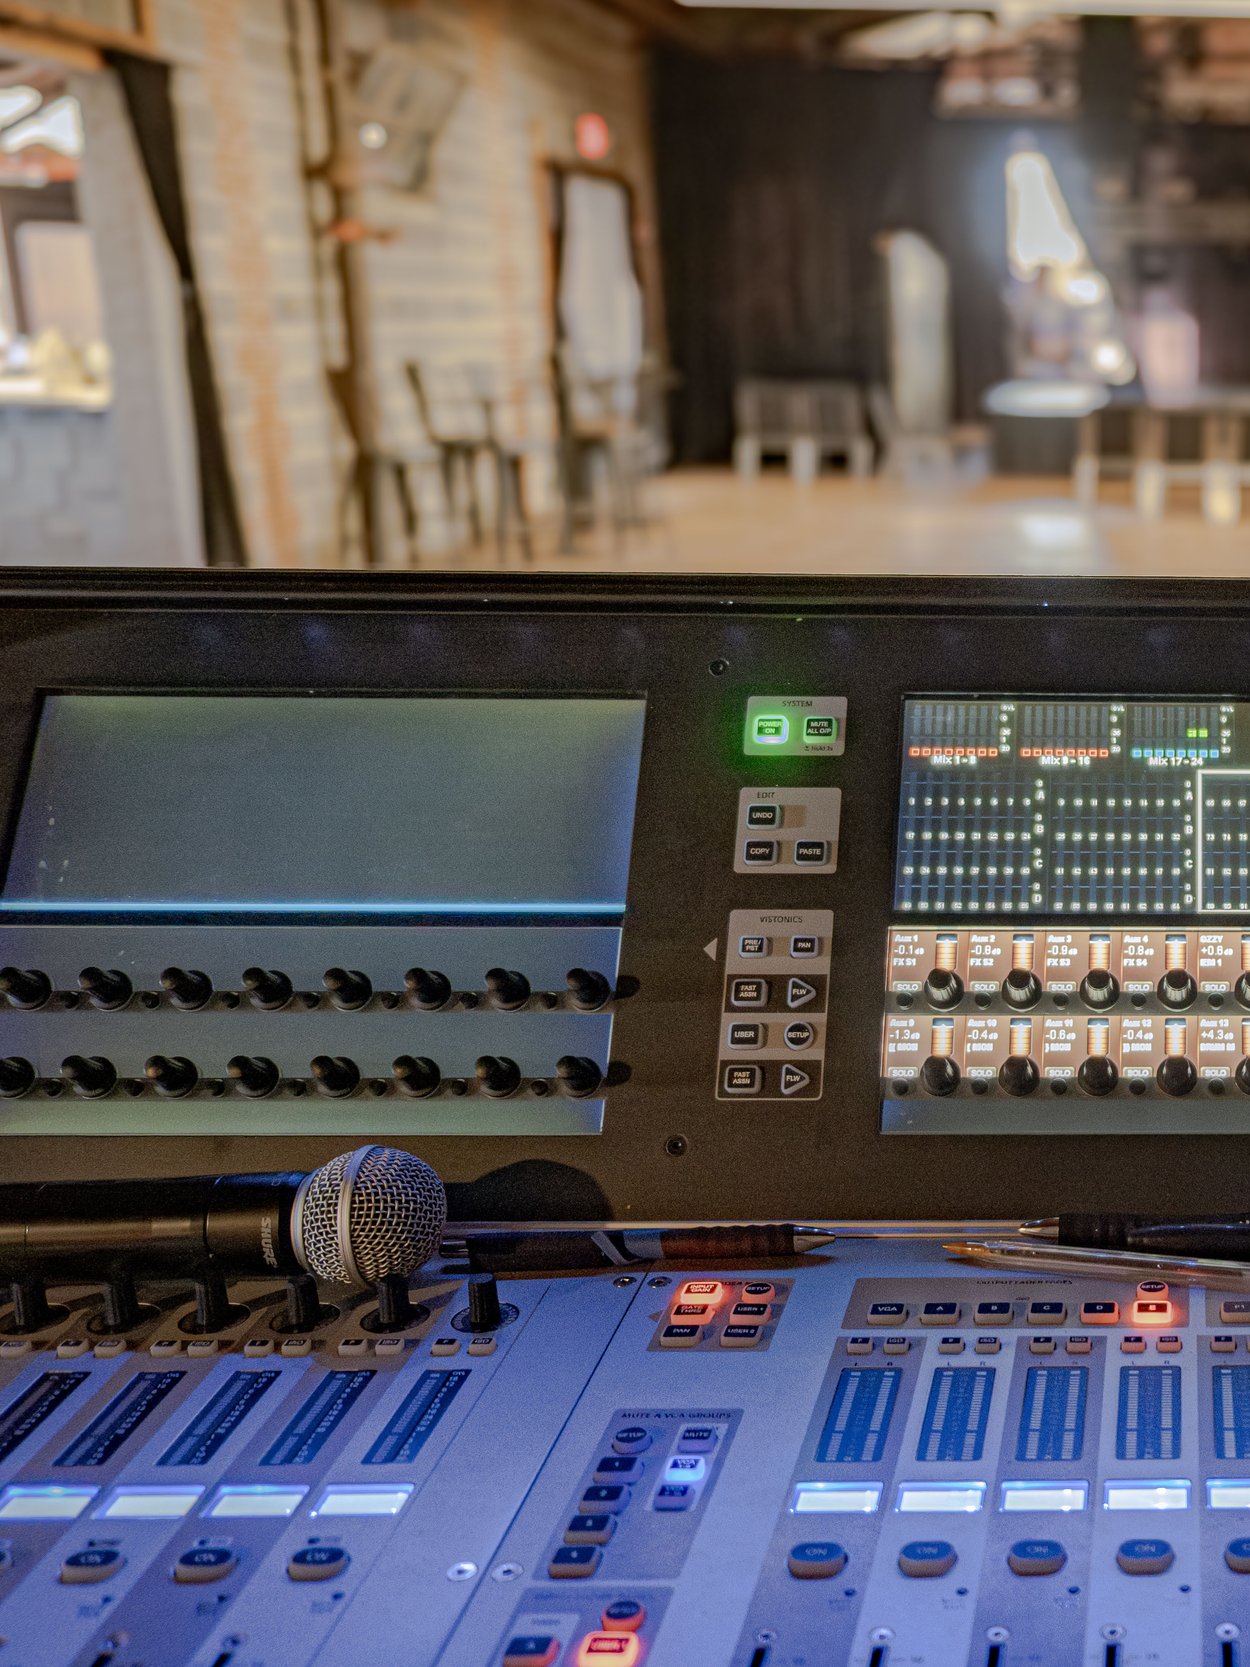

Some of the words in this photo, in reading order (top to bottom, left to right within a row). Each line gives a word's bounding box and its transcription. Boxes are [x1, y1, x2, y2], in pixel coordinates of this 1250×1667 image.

[781, 699, 813, 707] SYSTEM
[933, 755, 952, 764] Mix
[1041, 756, 1060, 765] Mix
[1148, 757, 1168, 765] Mix
[1190, 757, 1203, 766] 24
[756, 791, 775, 799] EDIT
[752, 811, 773, 819] UNDO
[749, 847, 770, 855] COPY
[798, 847, 821, 855] PASTE
[892, 1069, 914, 1077] SOLO
[970, 1069, 992, 1077] SOLO
[1049, 1069, 1071, 1077] SOLO
[1127, 1069, 1149, 1077] SOLO
[1204, 1069, 1226, 1077] SOLO
[260, 1216, 278, 1265] SHURE
